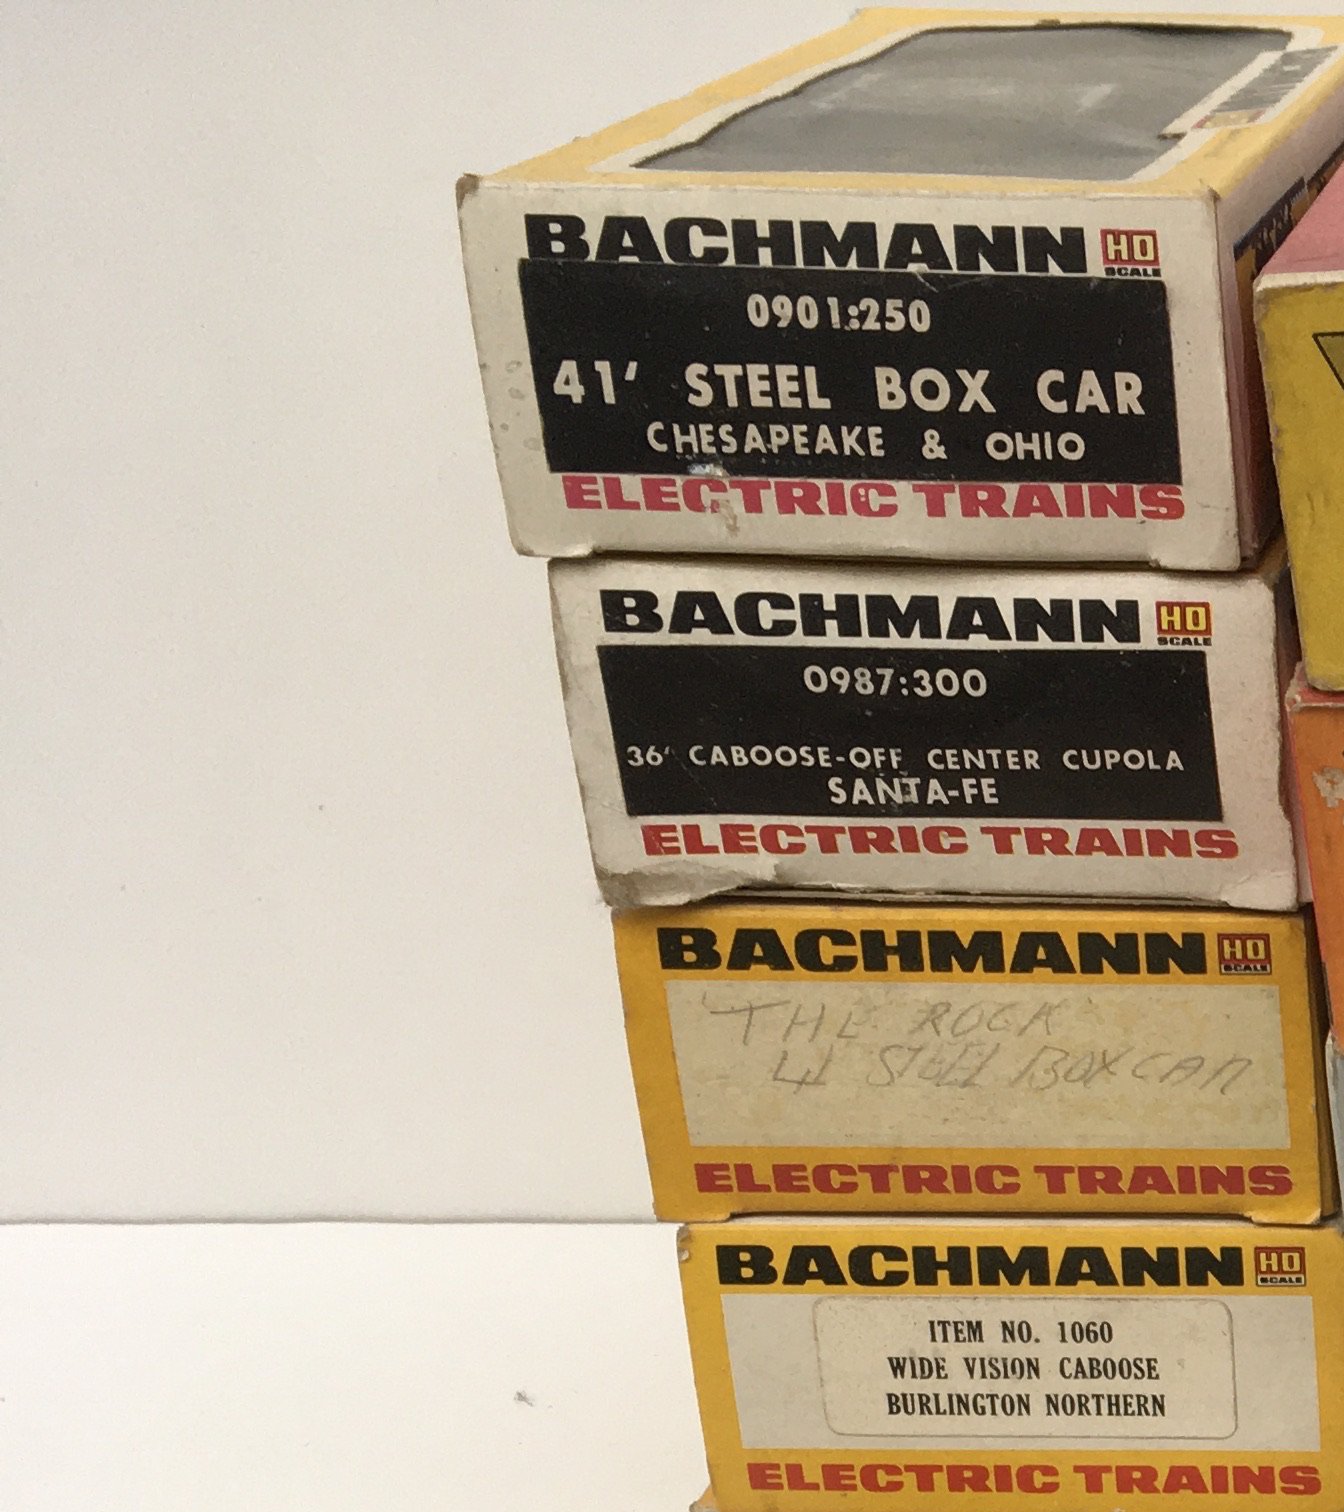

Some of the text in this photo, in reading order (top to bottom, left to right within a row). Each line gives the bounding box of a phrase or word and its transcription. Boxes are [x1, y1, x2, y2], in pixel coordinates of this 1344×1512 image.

[524, 214, 1087, 274] BACHMANN
[747, 294, 931, 333] 0901:250
[553, 360, 1146, 416] 41' STEEL BOX CAR
[647, 421, 1086, 462] CHESAPEAKE & OHIO
[562, 475, 1187, 521] ELECTRIC TRAINS
[599, 589, 1141, 643] BACHMANN
[803, 664, 989, 698] 0987:300
[689, 745, 1184, 772] CABOOSE-OFF CENTER CUPOLA
[829, 776, 999, 805] SANTA-FE
[642, 824, 1239, 860] ELECTRIC TRAINS
[657, 927, 1207, 974] BACHMANN
[694, 1163, 1293, 1197] ELECTRIC TRAINS
[715, 1244, 1244, 1287] BACHMANN
[928, 1320, 1113, 1344] ITEM NO. 1060
[887, 1356, 1160, 1381] WIDE VISION CABOOSE
[886, 1393, 1167, 1418] BURLINGTON NORTHERN
[747, 1462, 1323, 1496] ELECTRIC TRAINS
